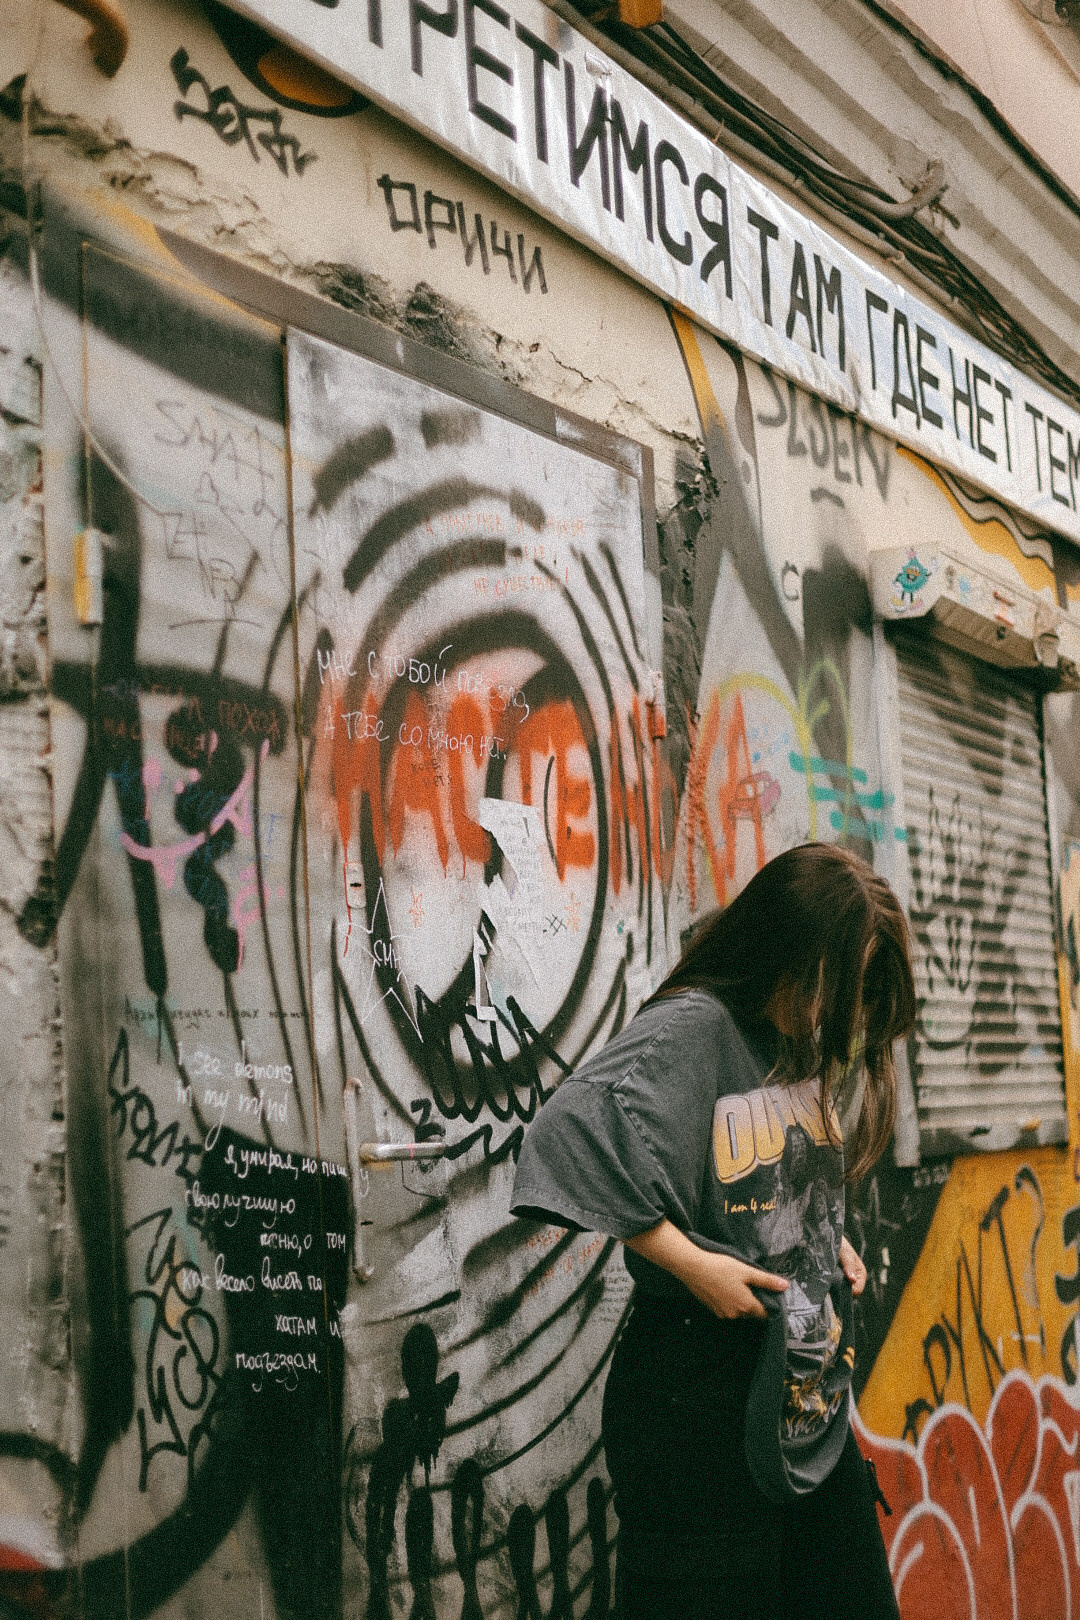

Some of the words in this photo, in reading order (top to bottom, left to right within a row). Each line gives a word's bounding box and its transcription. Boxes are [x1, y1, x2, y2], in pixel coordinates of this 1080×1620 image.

[747, 206, 846, 373] ТАМ
[865, 287, 943, 430] ГДЕ
[948, 346, 1013, 473] НЕТ
[234, 1039, 293, 1084] demons
[203, 1089, 230, 1152] my
[238, 1088, 289, 1125] mind
[730, 1204, 748, 1213] am
[750, 1197, 757, 1214] 4
[760, 1195, 777, 1211] real
[214, 1253, 256, 1292] весело
[261, 1256, 303, 1291] висеть
